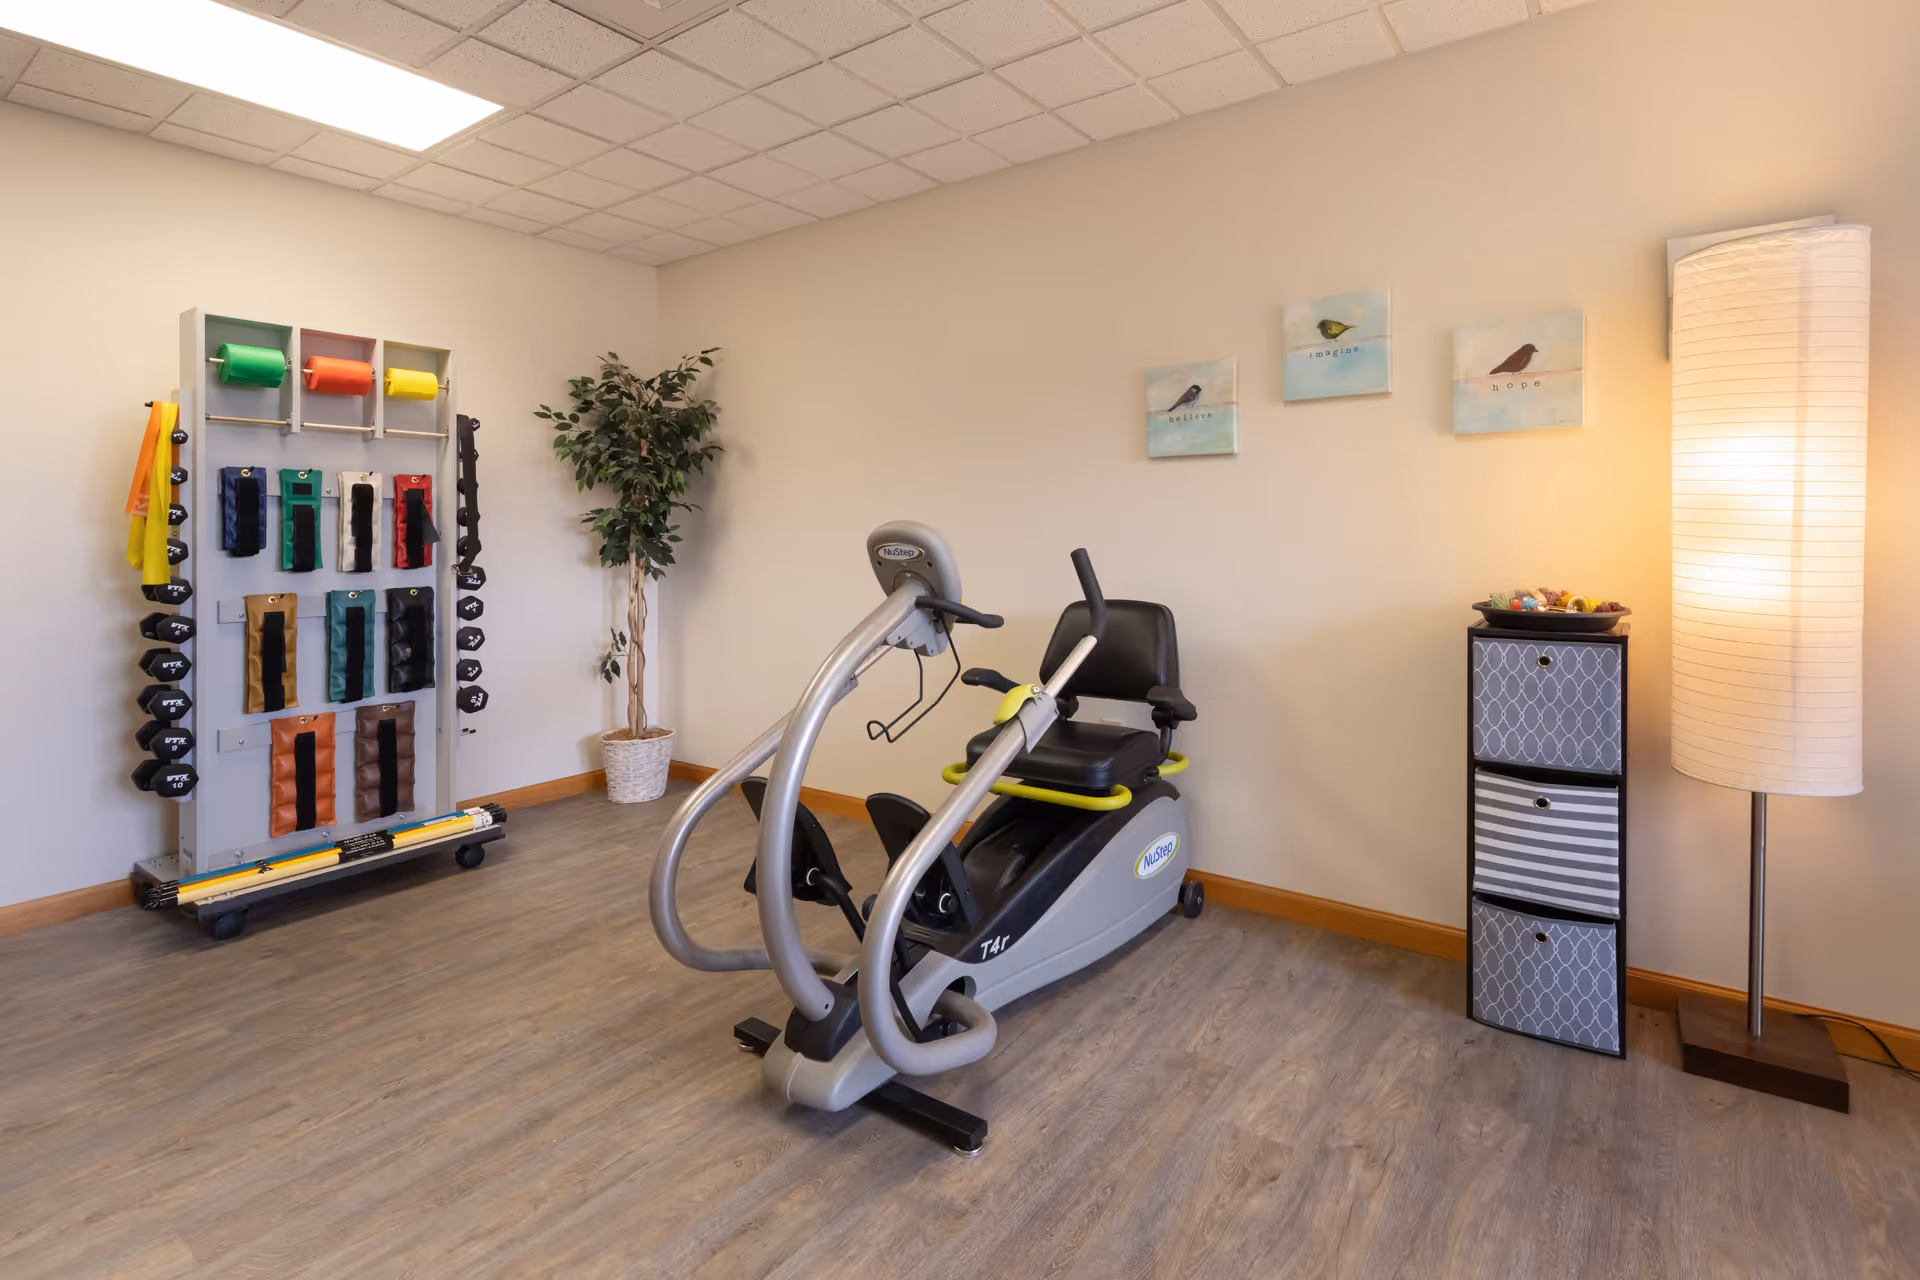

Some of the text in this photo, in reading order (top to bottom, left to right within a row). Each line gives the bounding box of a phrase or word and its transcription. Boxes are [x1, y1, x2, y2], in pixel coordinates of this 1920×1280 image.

[1309, 347, 1359, 358] imagine
[1492, 381, 1541, 391] hope
[1169, 413, 1212, 423] believe
[883, 548, 915, 557] NuStep
[171, 622, 190, 632] VTX
[162, 660, 184, 668] VTX
[164, 737, 187, 745] VTX
[171, 744, 178, 752] 9
[166, 773, 190, 782] VTX
[171, 781, 184, 789] 10
[1143, 841, 1173, 870] NuStep
[980, 934, 1010, 960] T4r
